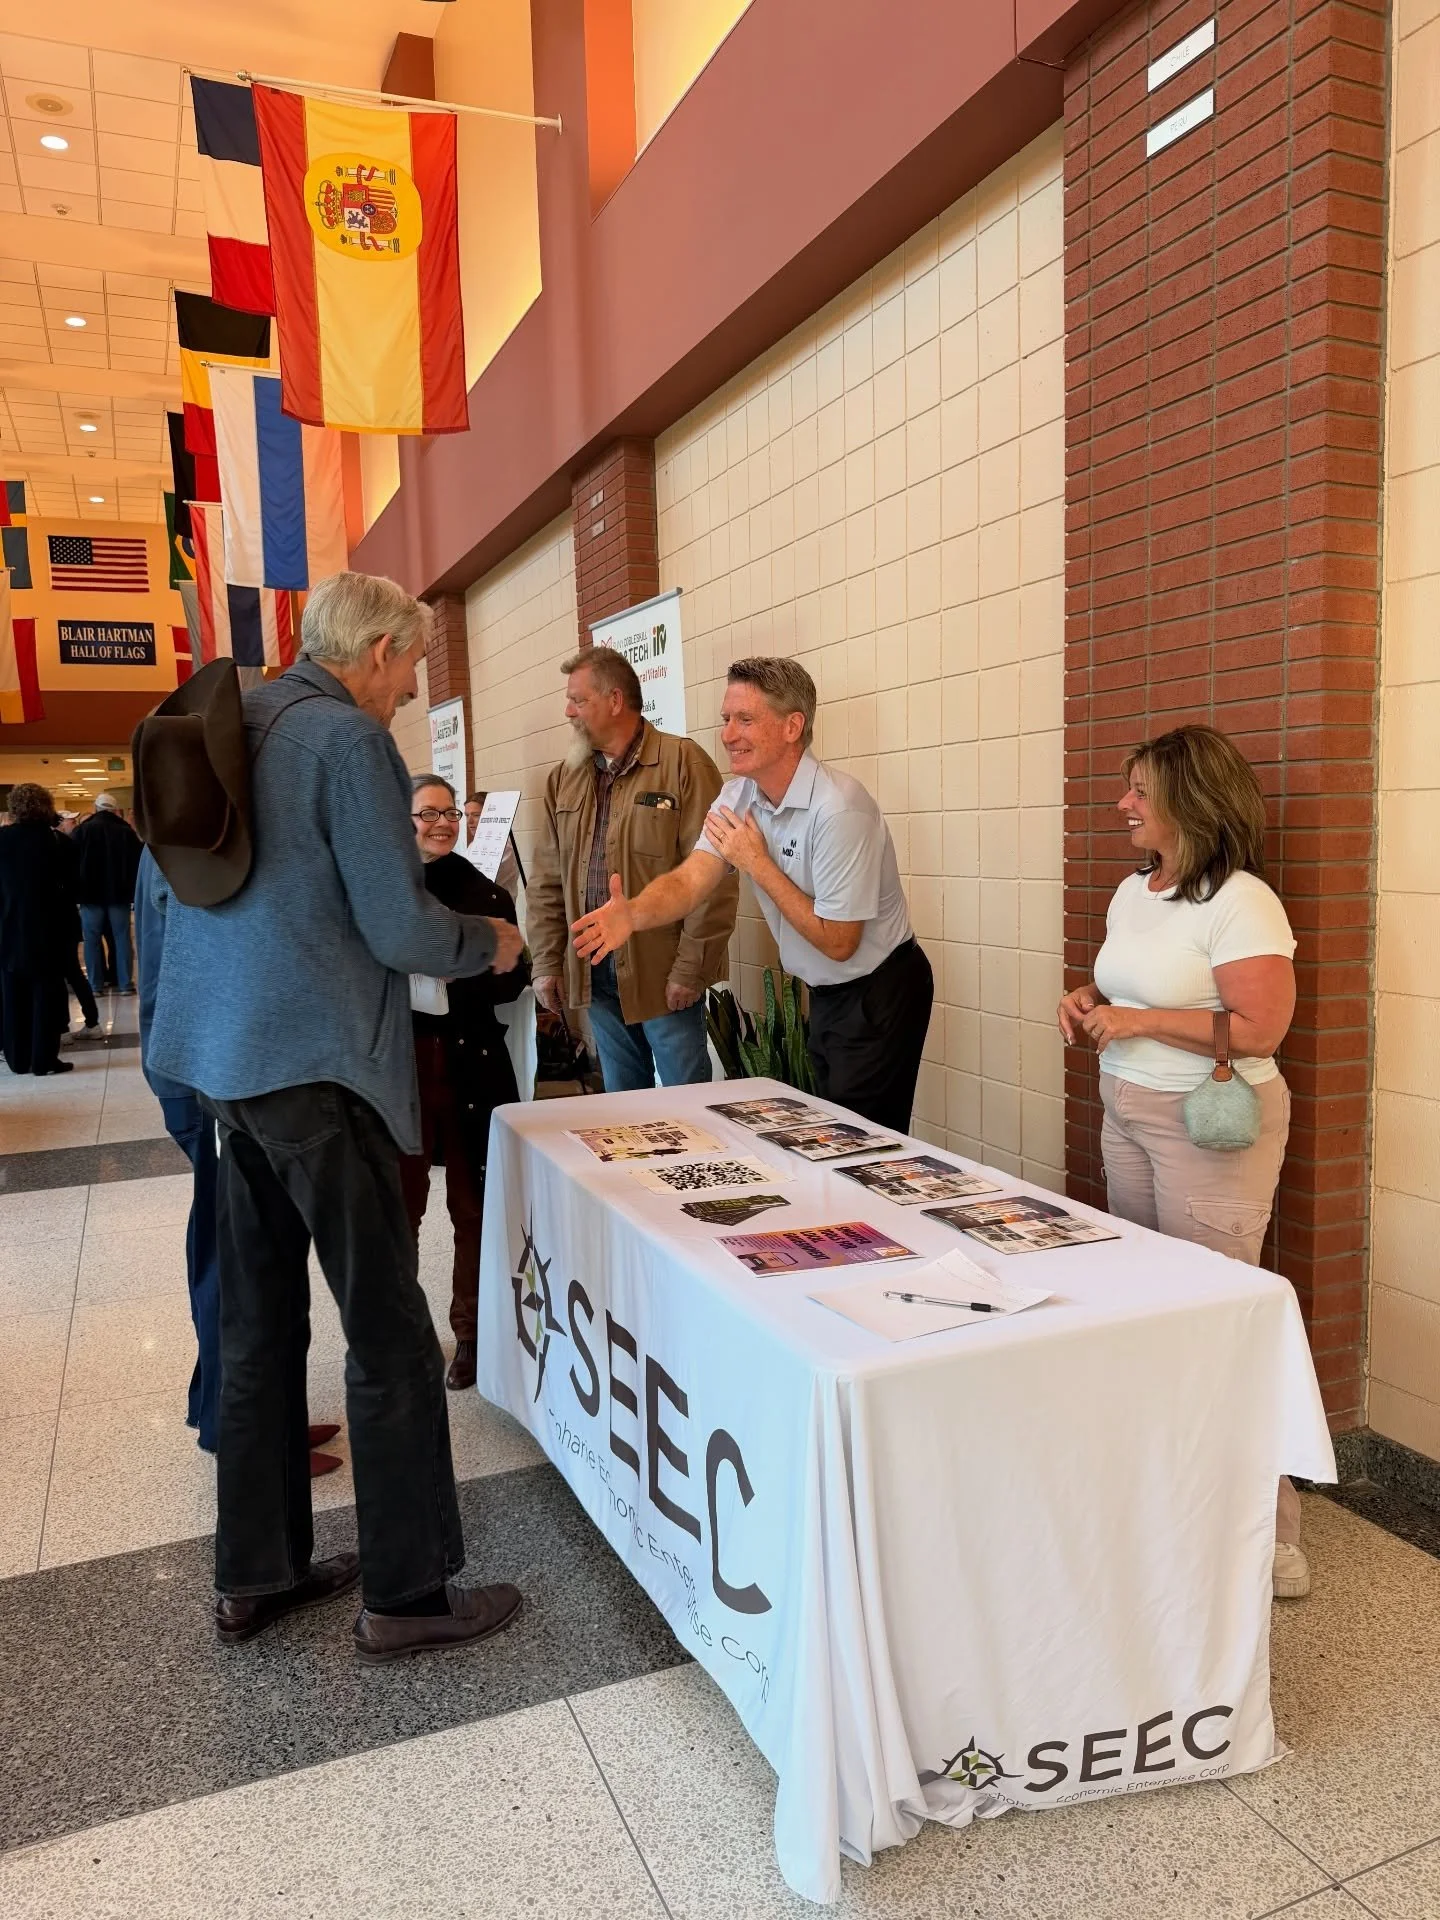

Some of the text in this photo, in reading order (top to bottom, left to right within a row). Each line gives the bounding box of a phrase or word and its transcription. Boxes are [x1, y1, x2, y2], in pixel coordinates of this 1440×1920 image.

[60, 627, 153, 643] BLAIR HARTMAN
[70, 645, 146, 659] HALL OF FLAGS
[568, 1279, 772, 1615] SEEC
[721, 1636, 770, 1704] Corp
[1024, 1704, 1234, 1793] SEEC
[1126, 1773, 1196, 1792] Enterprise
[1199, 1762, 1231, 1779] Corp
